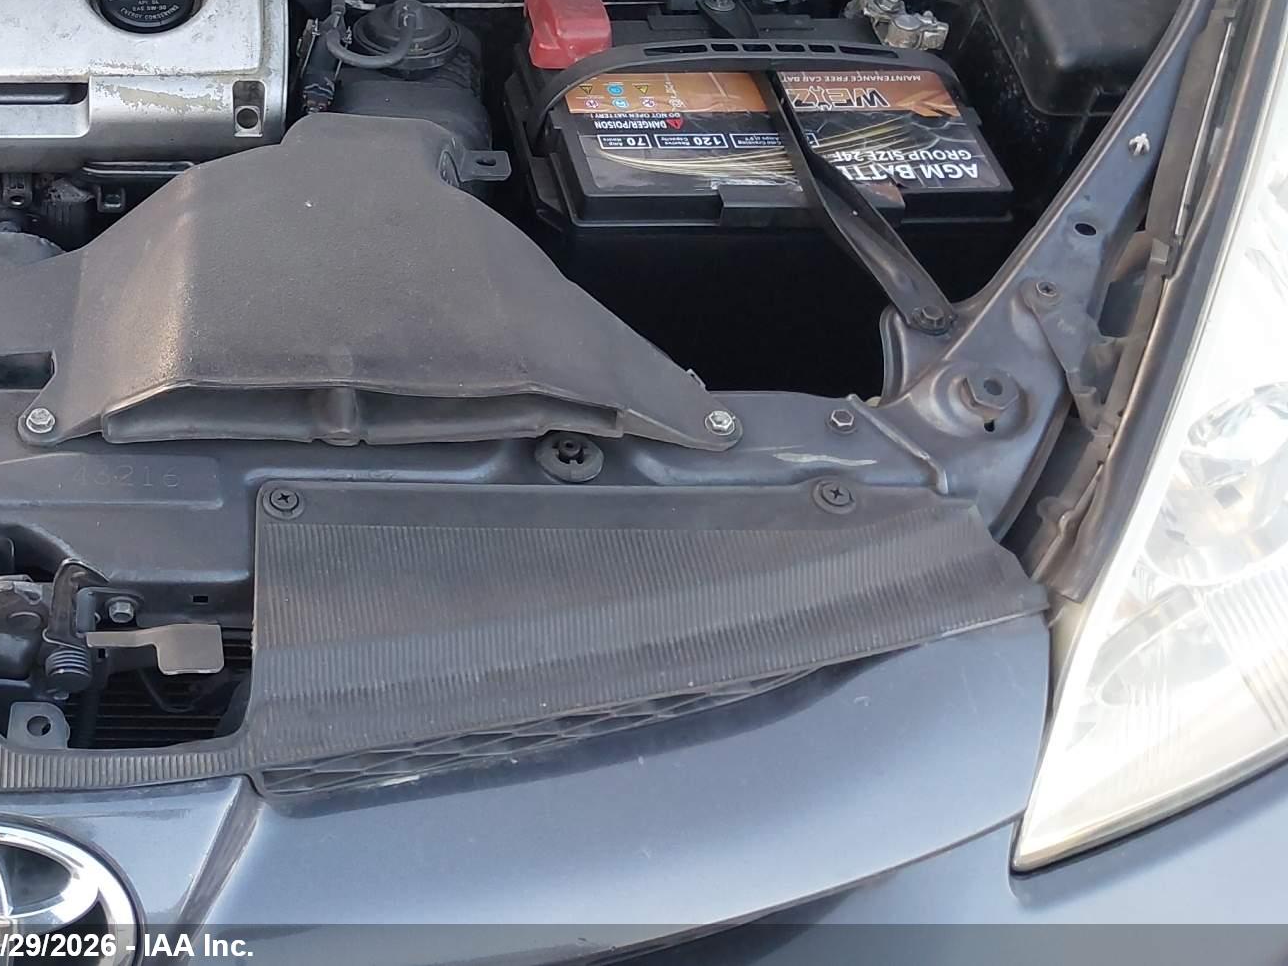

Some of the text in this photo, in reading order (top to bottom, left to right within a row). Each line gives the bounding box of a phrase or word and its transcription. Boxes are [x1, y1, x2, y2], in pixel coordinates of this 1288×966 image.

[802, 75, 822, 83] CAR
[594, 120, 668, 129] DANGER/POISON
[626, 137, 646, 146] 70
[693, 136, 722, 146] 120
[867, 150, 904, 162] SIZE
[909, 149, 972, 161] GROUP
[920, 163, 980, 180] AGM
